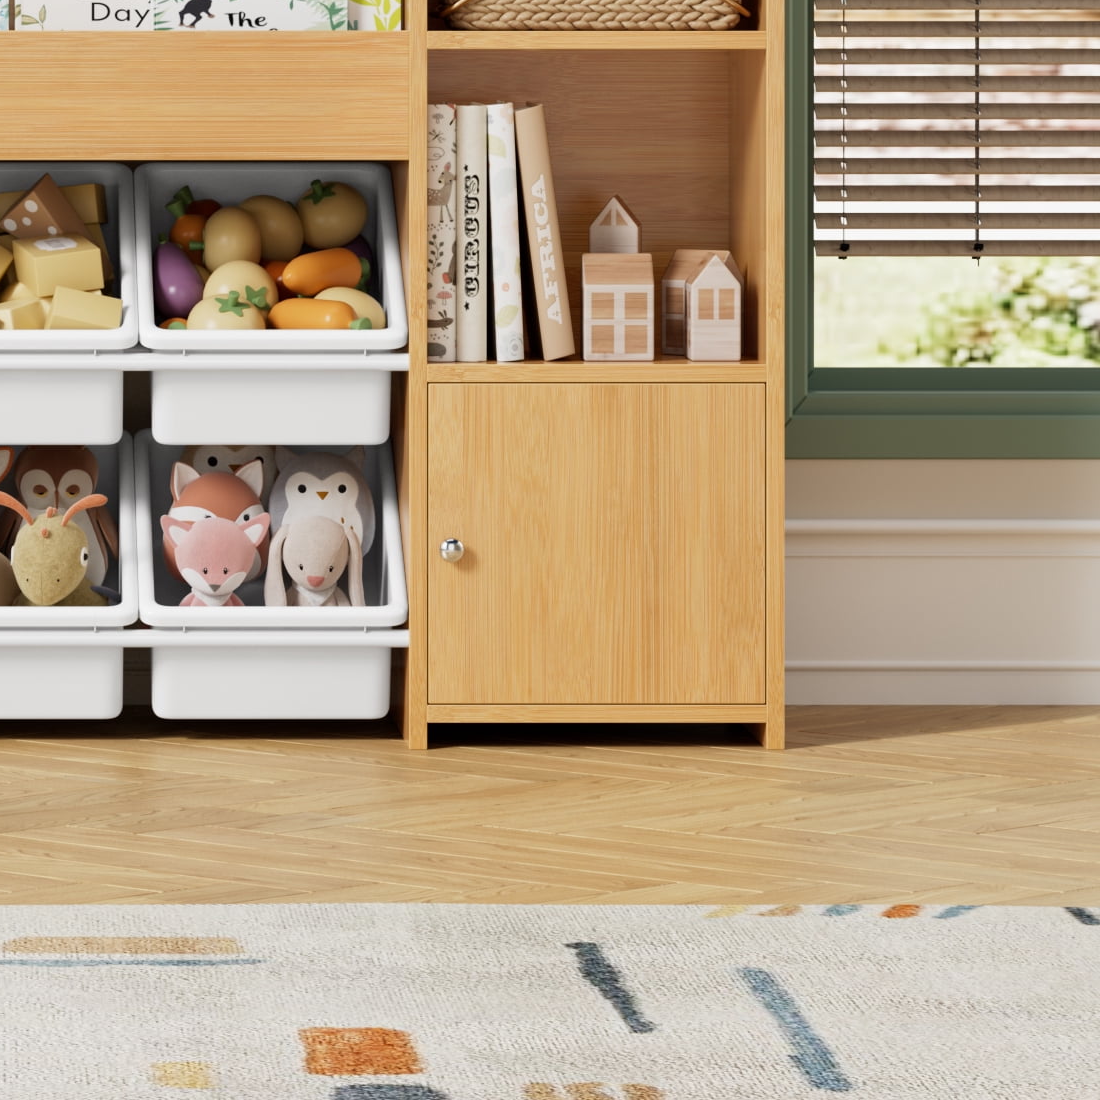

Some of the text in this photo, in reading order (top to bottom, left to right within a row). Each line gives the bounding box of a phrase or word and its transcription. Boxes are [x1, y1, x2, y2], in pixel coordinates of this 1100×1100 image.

[91, 2, 151, 28] Day
[224, 12, 268, 28] The
[464, 174, 480, 298] CIRCUS
[531, 173, 563, 325] AFRICA
